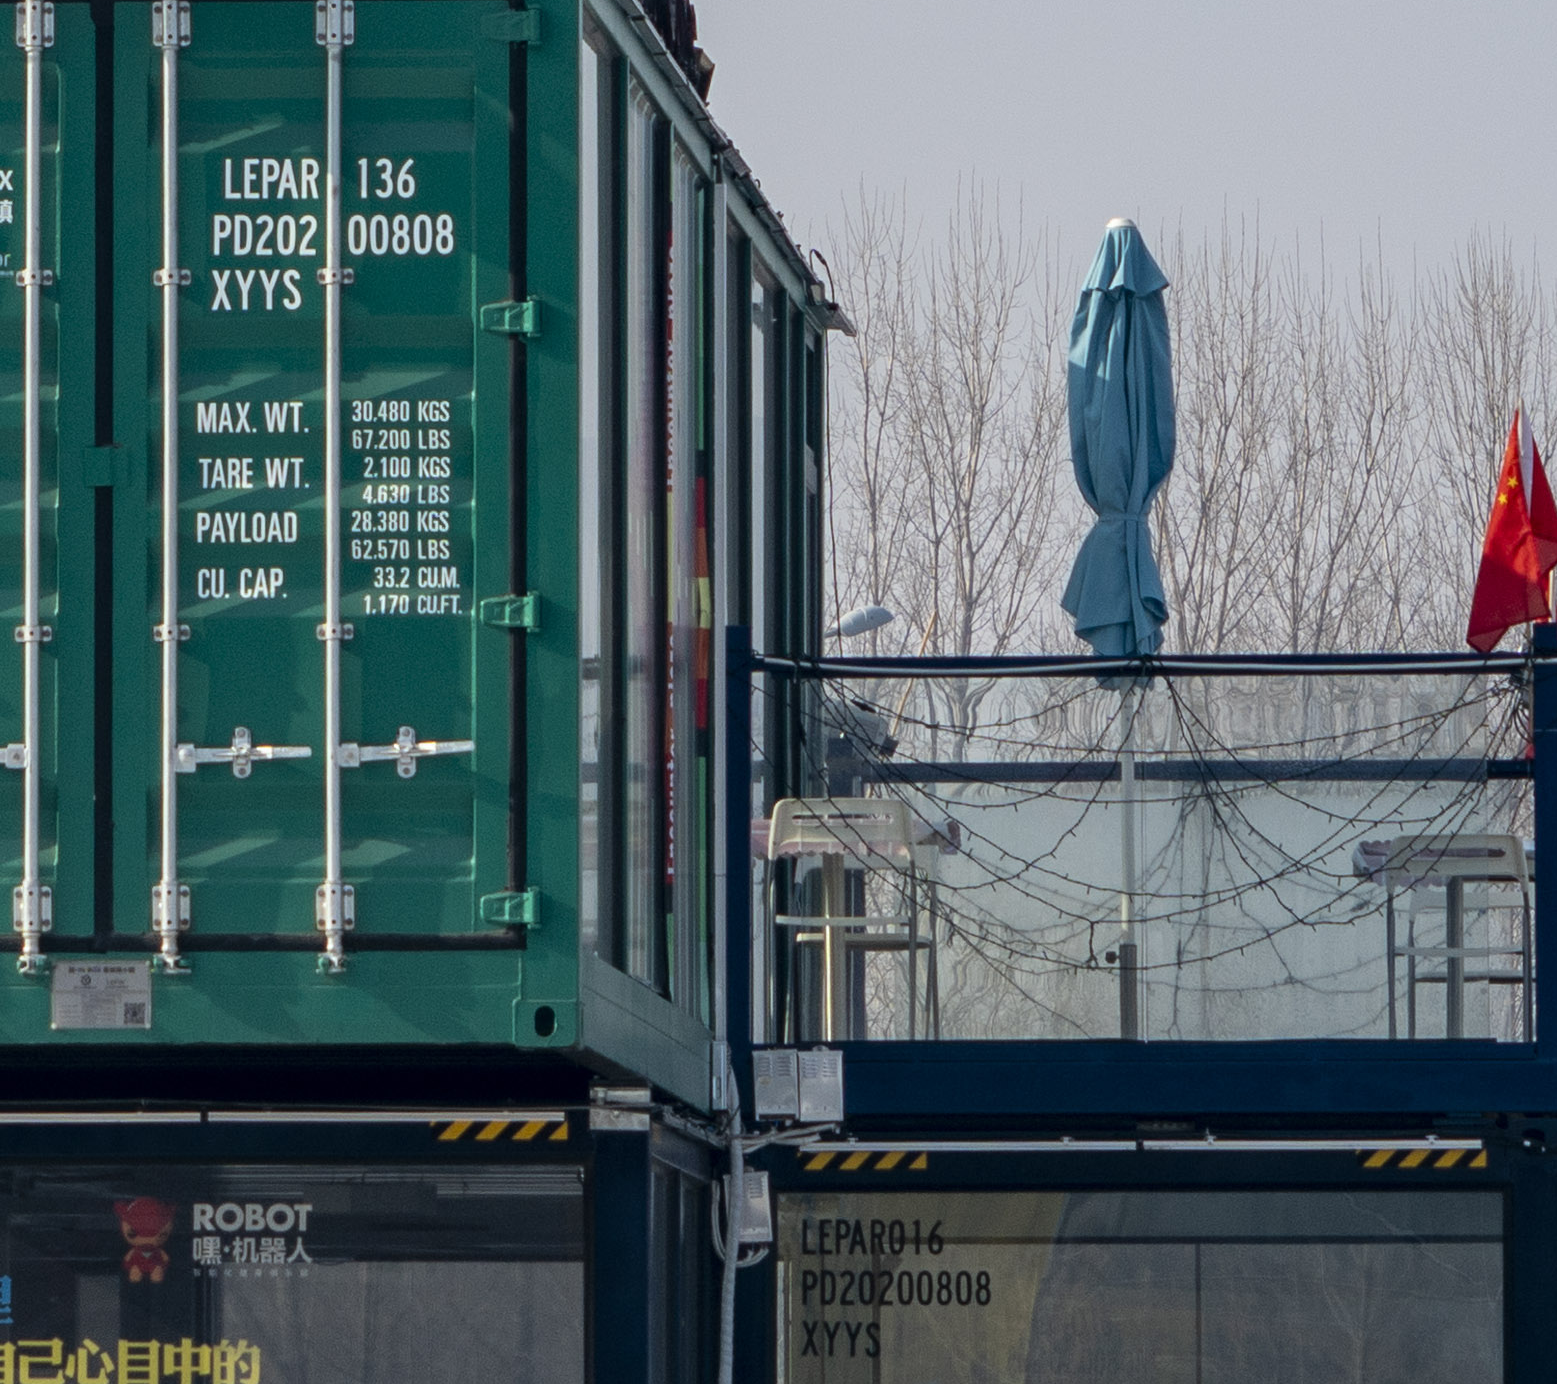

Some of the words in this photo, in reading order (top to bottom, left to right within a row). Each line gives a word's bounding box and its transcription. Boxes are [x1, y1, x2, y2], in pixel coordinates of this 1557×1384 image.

[358, 158, 416, 199] 136
[211, 269, 302, 311] XYYS
[197, 402, 257, 433] MAX.
[264, 402, 309, 433] WT.
[418, 401, 450, 422] KGS
[418, 430, 450, 450] LBS
[199, 458, 253, 489] TARE
[265, 458, 310, 489] WT.
[418, 457, 450, 478] KGS
[417, 485, 450, 504] LBS
[197, 512, 298, 543] PAYLOAD
[417, 511, 449, 532] KGS
[417, 540, 450, 560] LBS
[198, 568, 229, 599] CU.
[239, 568, 287, 599] CAP.
[373, 567, 410, 588] 33.2
[193, 1204, 312, 1232] ROBOT
[801, 1219, 944, 1255] LEPAR016
[801, 1270, 991, 1306] PD20200808
[801, 1320, 881, 1358] XYYS
